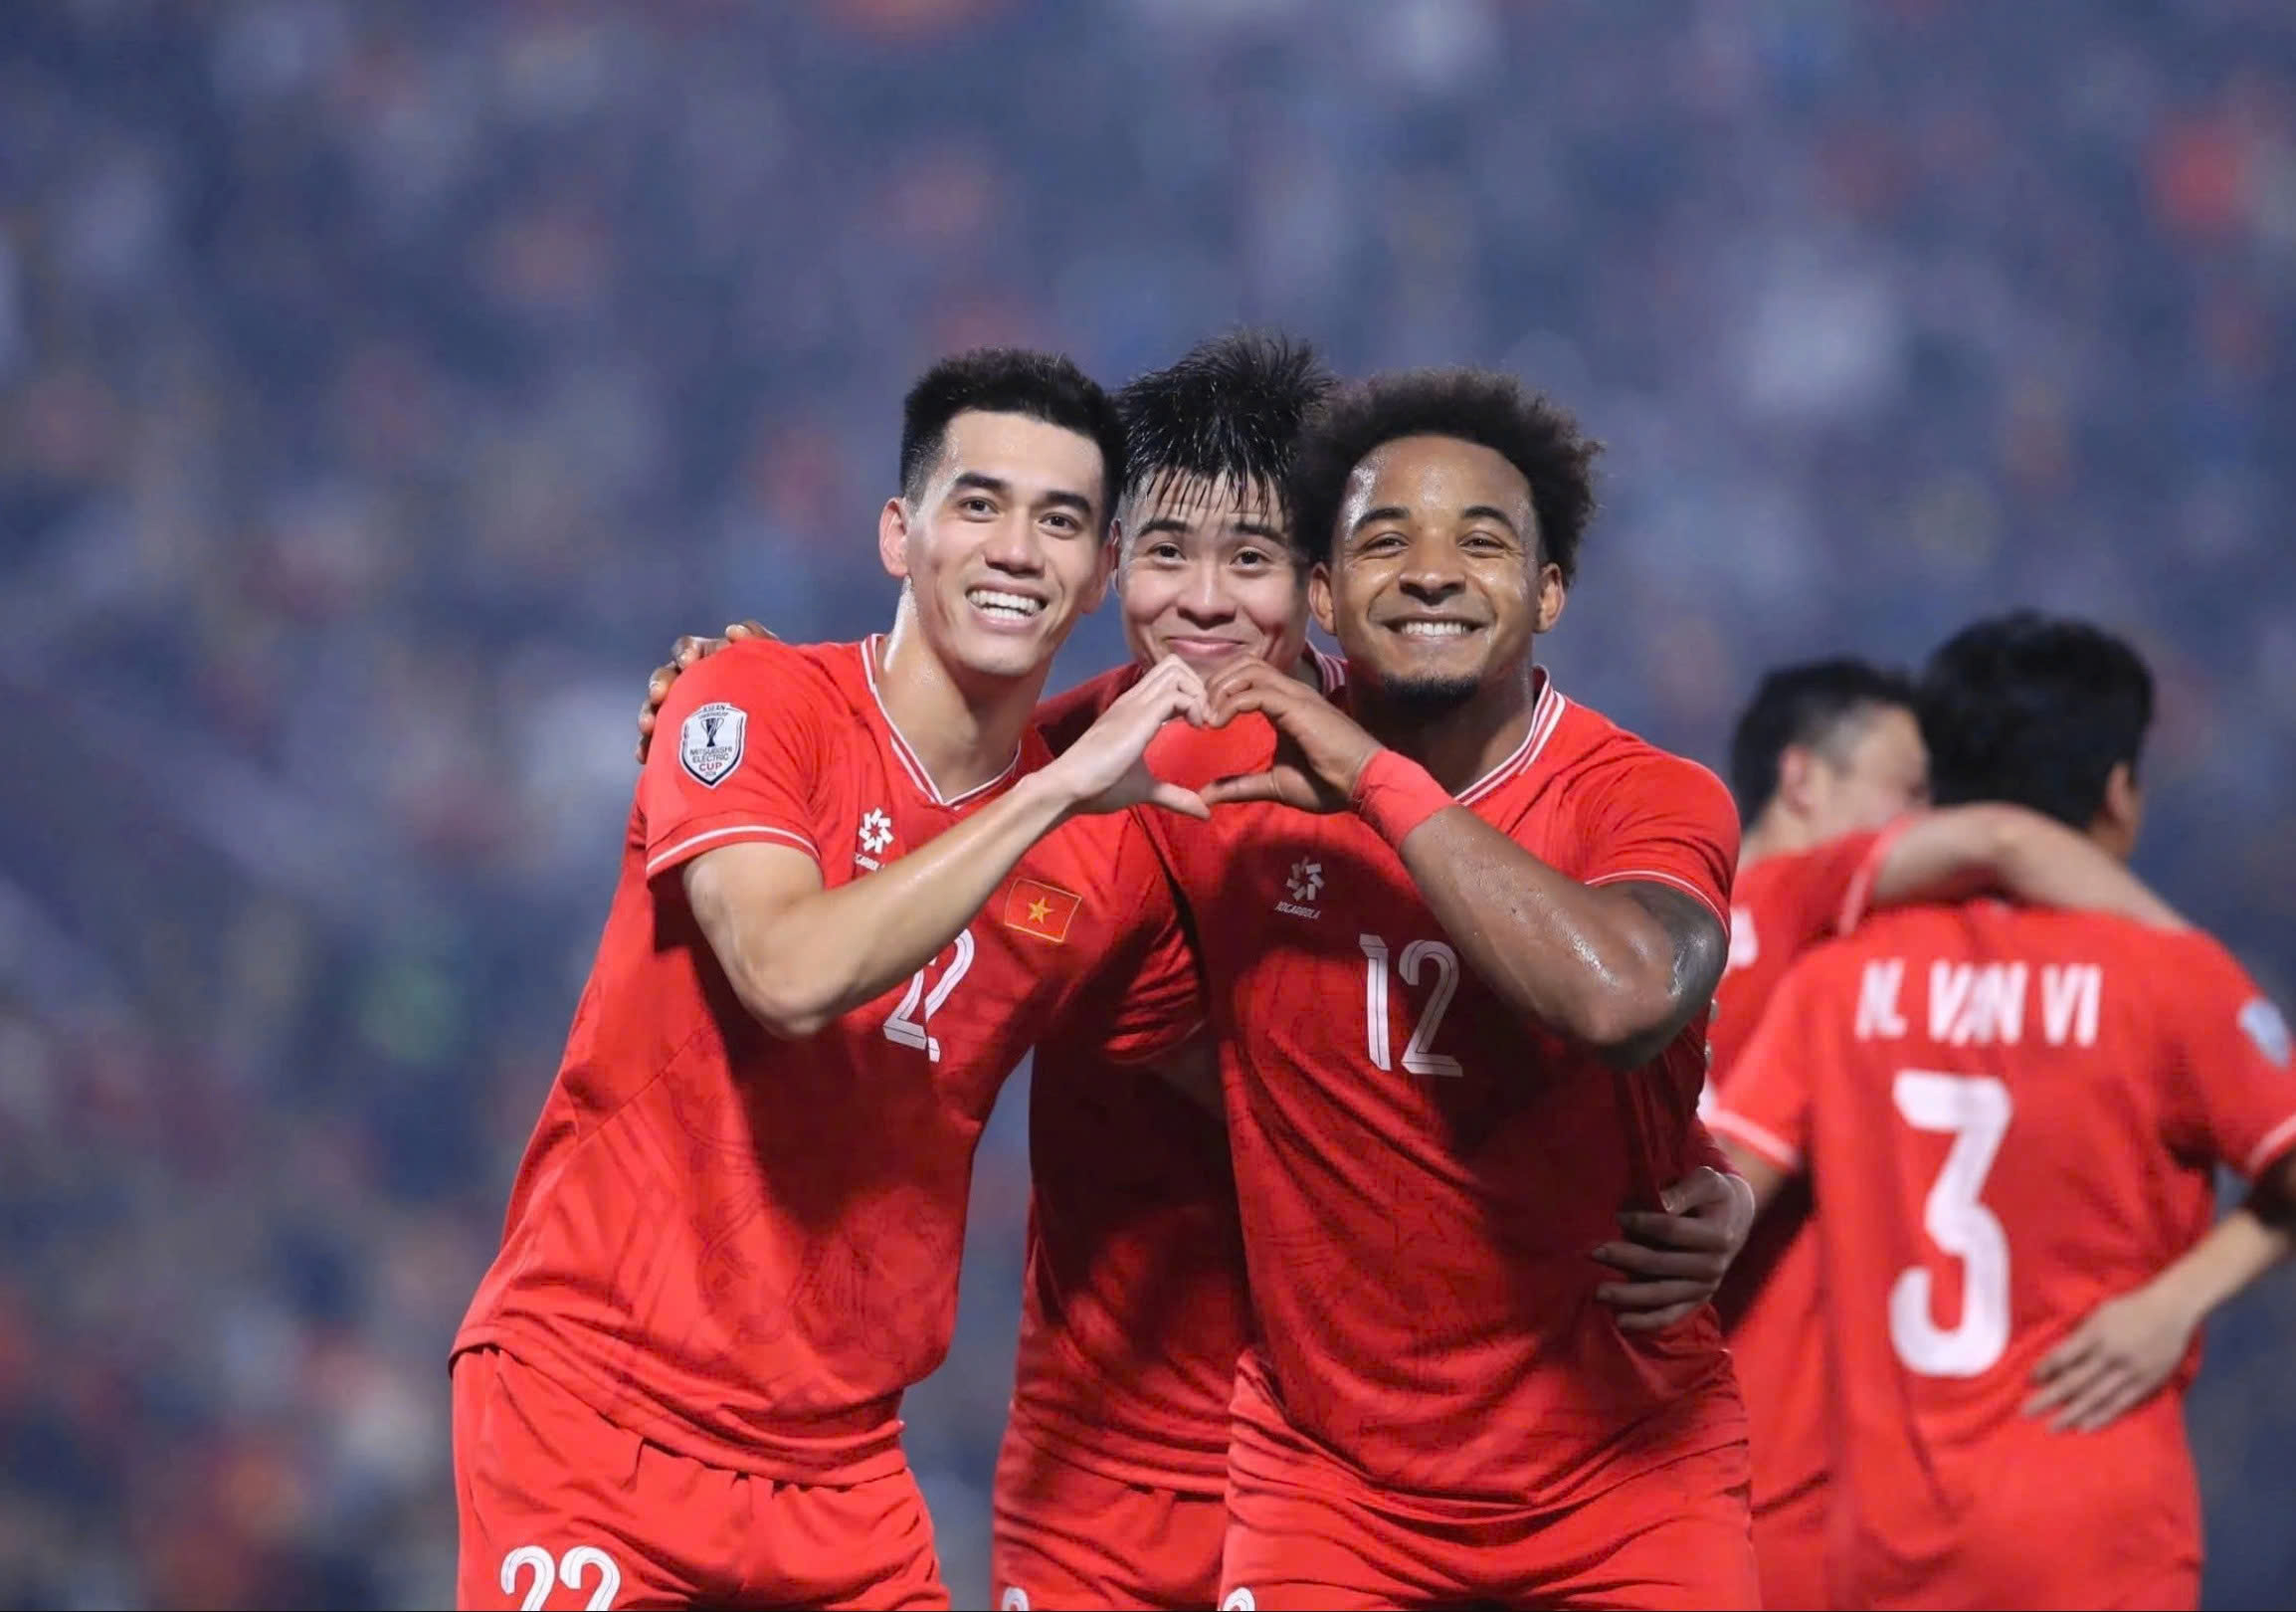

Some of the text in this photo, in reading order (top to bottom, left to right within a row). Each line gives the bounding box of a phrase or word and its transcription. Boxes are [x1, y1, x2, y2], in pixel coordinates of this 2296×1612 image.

[698, 762, 722, 771] CUP
[1359, 933, 1463, 1078] 12
[2041, 961, 2104, 1046] VI
[1889, 1068, 2012, 1377] 3
[500, 1544, 622, 1611] 22
